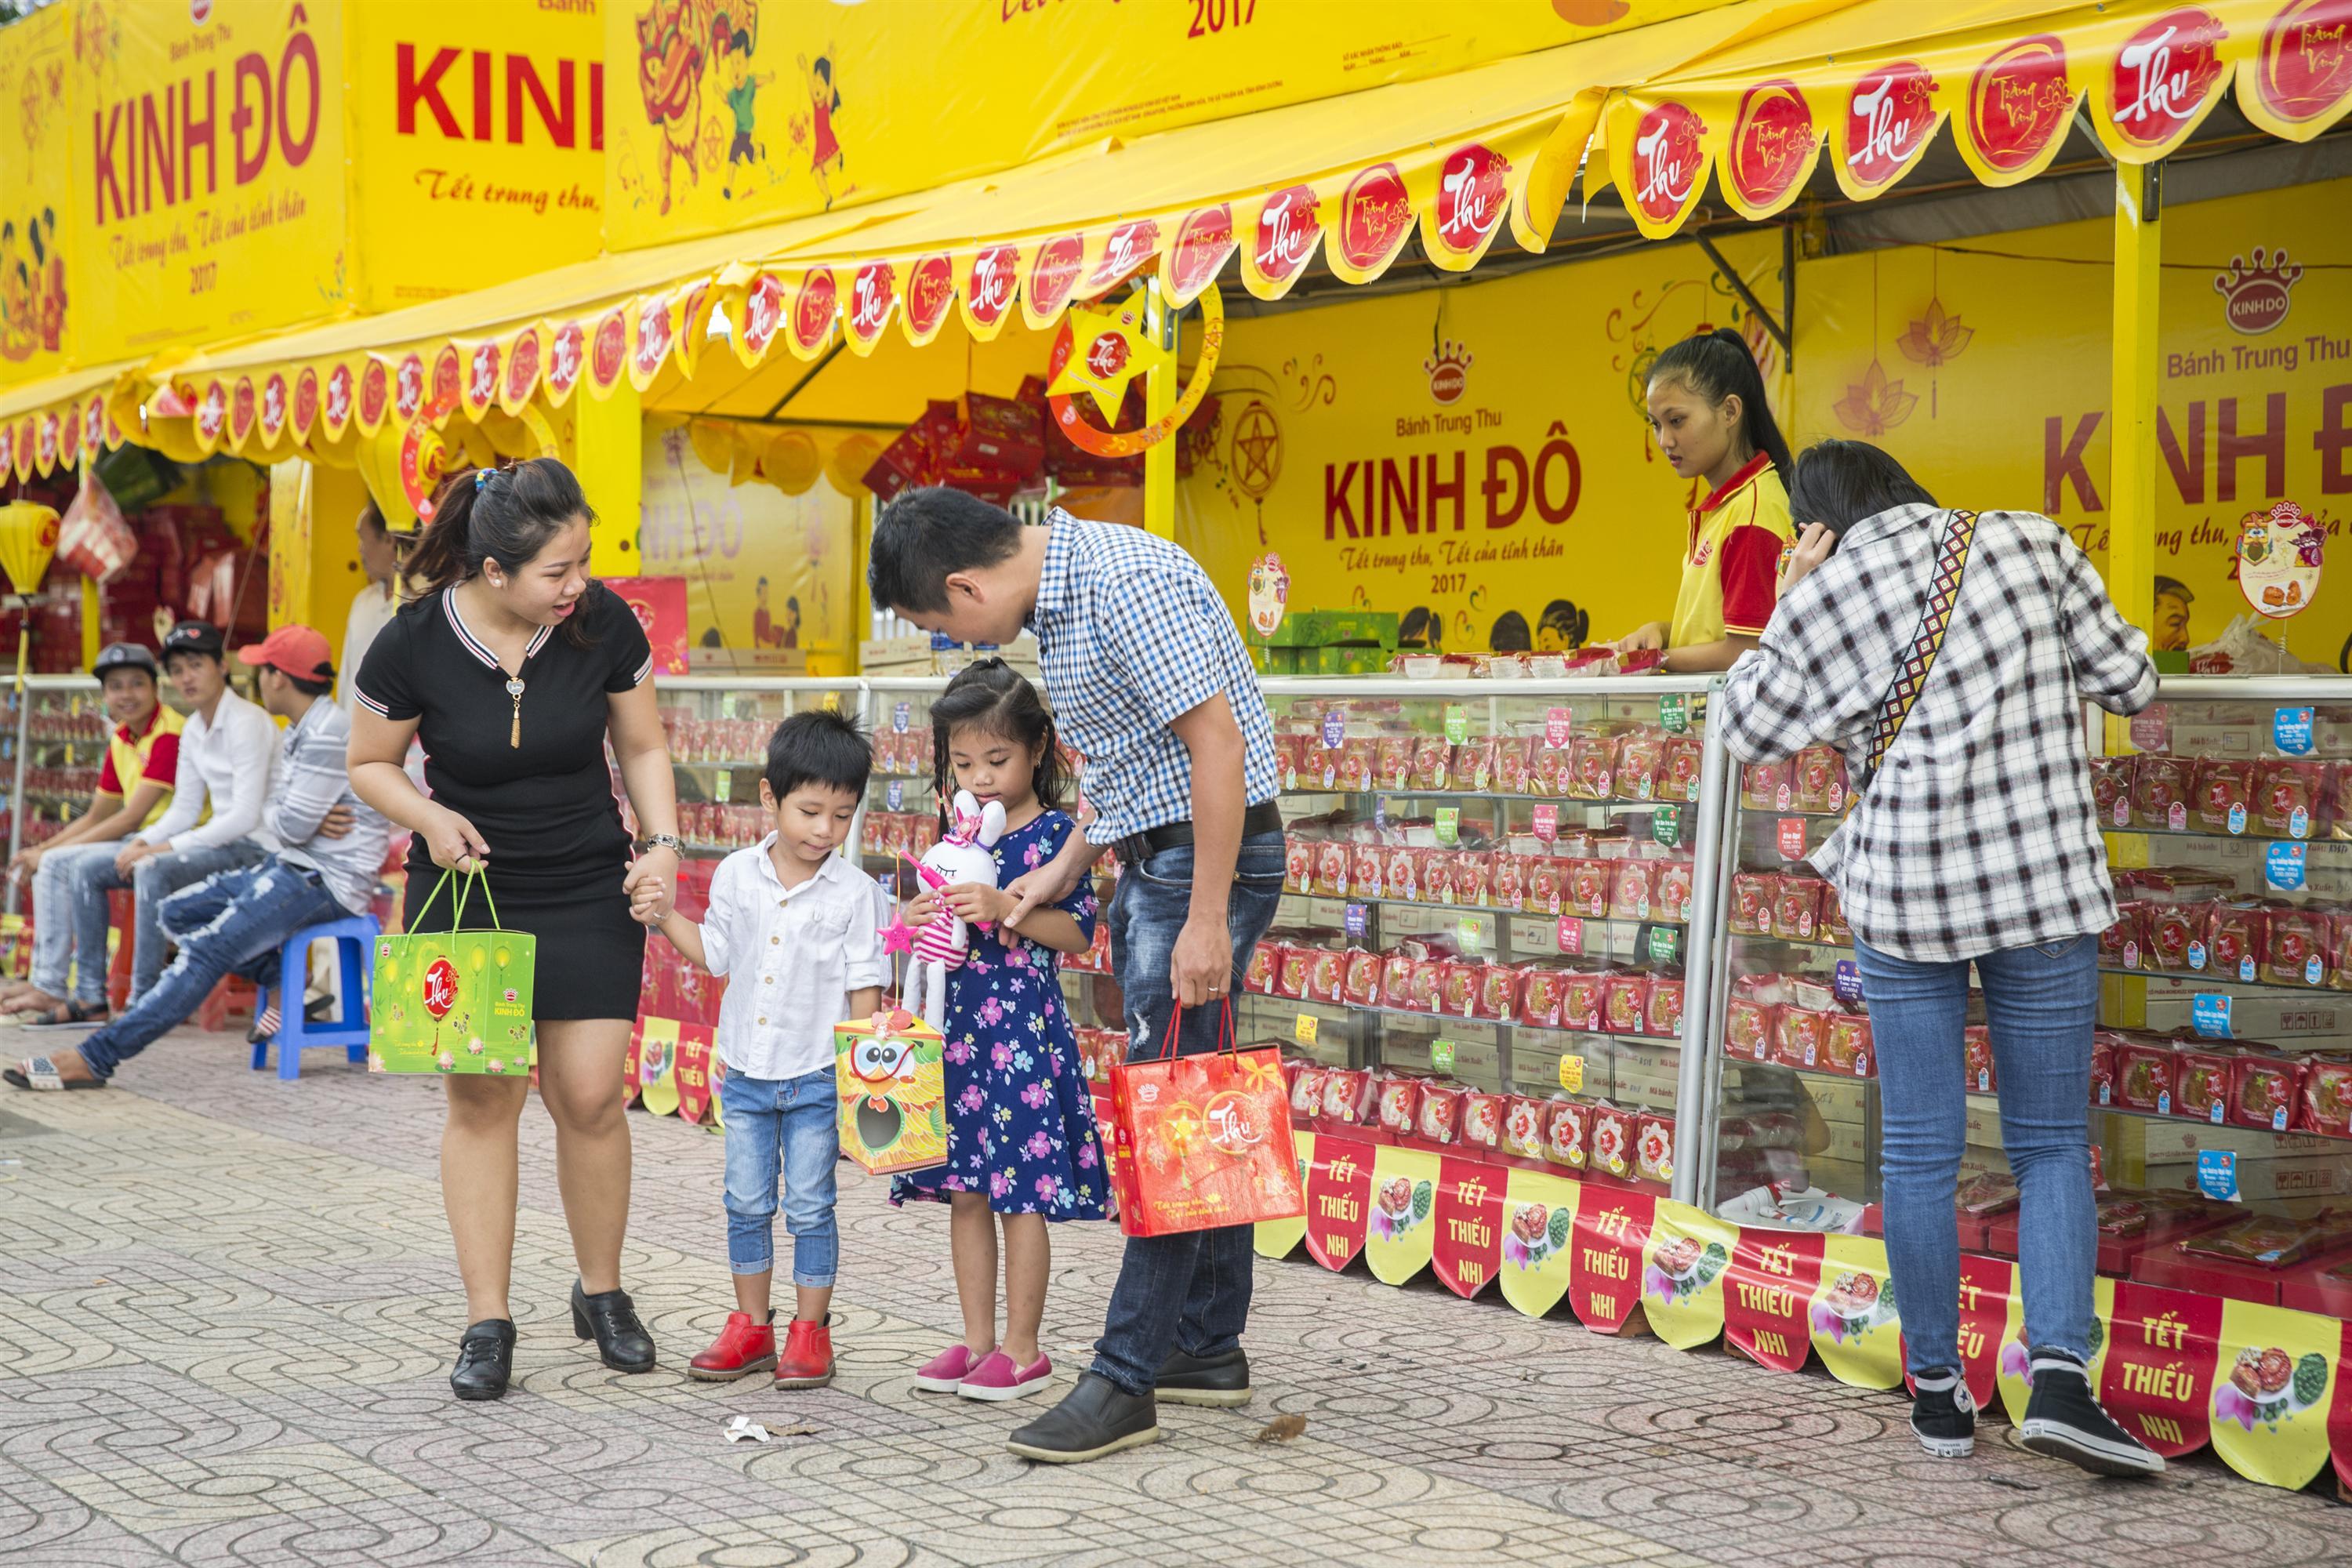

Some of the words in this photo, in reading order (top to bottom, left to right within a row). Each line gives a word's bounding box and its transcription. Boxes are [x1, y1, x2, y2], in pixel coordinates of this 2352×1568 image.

[2292, 21, 2347, 49] Trăng
[2114, 26, 2205, 122] Thu
[2307, 49, 2344, 78] Vàng
[396, 41, 604, 152] KIN
[1991, 74, 2036, 108] Trăng
[93, 68, 216, 227] KINH
[230, 2, 321, 187] ĐÔ
[1847, 74, 1921, 165] Thu
[2005, 103, 2038, 129] Vàng
[1751, 121, 1787, 153] Trăng
[1637, 118, 1693, 203] Thu
[1761, 147, 1788, 169] Vàng
[413, 167, 477, 201] Tết
[482, 183, 549, 216] trung
[556, 182, 601, 214] thu,
[1439, 158, 1497, 235] Thu
[1356, 196, 1388, 225] Trăng
[1255, 194, 1311, 265] Thu
[1365, 219, 1388, 238] Vàng
[188, 260, 218, 296] 2017
[969, 248, 1008, 311] Thu
[743, 282, 784, 343] Thu
[854, 267, 895, 328] Thu
[1086, 338, 1117, 377] Thu
[2168, 351, 2226, 379] Bánh
[2231, 343, 2299, 372] Trung
[2304, 335, 2350, 362] Thu
[1396, 416, 1430, 437] Bánh
[1433, 412, 1472, 434] Trung
[1475, 408, 1502, 428] Thu
[2043, 392, 2286, 516] KNH
[1323, 449, 1466, 541] KINH
[1481, 420, 1583, 530] ĐÔ
[694, 487, 744, 559] ĐÔ
[2190, 516, 2228, 546] thu,
[1338, 547, 1369, 572] Tết
[1372, 552, 1406, 574] trung
[1410, 546, 1434, 568] thu,
[1438, 539, 1470, 566] Tết
[1473, 539, 1497, 564] của
[1431, 573, 1468, 594] 2017
[424, 967, 455, 1008] Thu
[495, 1007, 512, 1016] KINH
[513, 1007, 525, 1017] ĐÔ
[685, 1036, 703, 1059] TẾT
[678, 1064, 705, 1088] THIẾU
[685, 1095, 699, 1115] NHI
[1209, 1101, 1263, 1144] Thu
[1329, 1154, 1357, 1185] TẾT
[1319, 1191, 1359, 1223] THIẾU
[1457, 1176, 1488, 1208] TẾT
[1447, 1217, 1491, 1250] THIẾU
[1597, 1207, 1632, 1238] TẾT
[1326, 1234, 1348, 1260] NHI
[1583, 1243, 1630, 1281] THIẾU
[1759, 1243, 1798, 1277] TẾT
[1457, 1259, 1483, 1287] NHI
[1590, 1291, 1616, 1321] NHI
[1737, 1280, 1795, 1319] THIẾU
[1958, 1276, 1982, 1312] ẾT
[1754, 1326, 1788, 1359] NHI
[2142, 1311, 2189, 1351] TẾT
[2121, 1363, 2194, 1403] THIẾU
[2139, 1412, 2185, 1446] NHI
